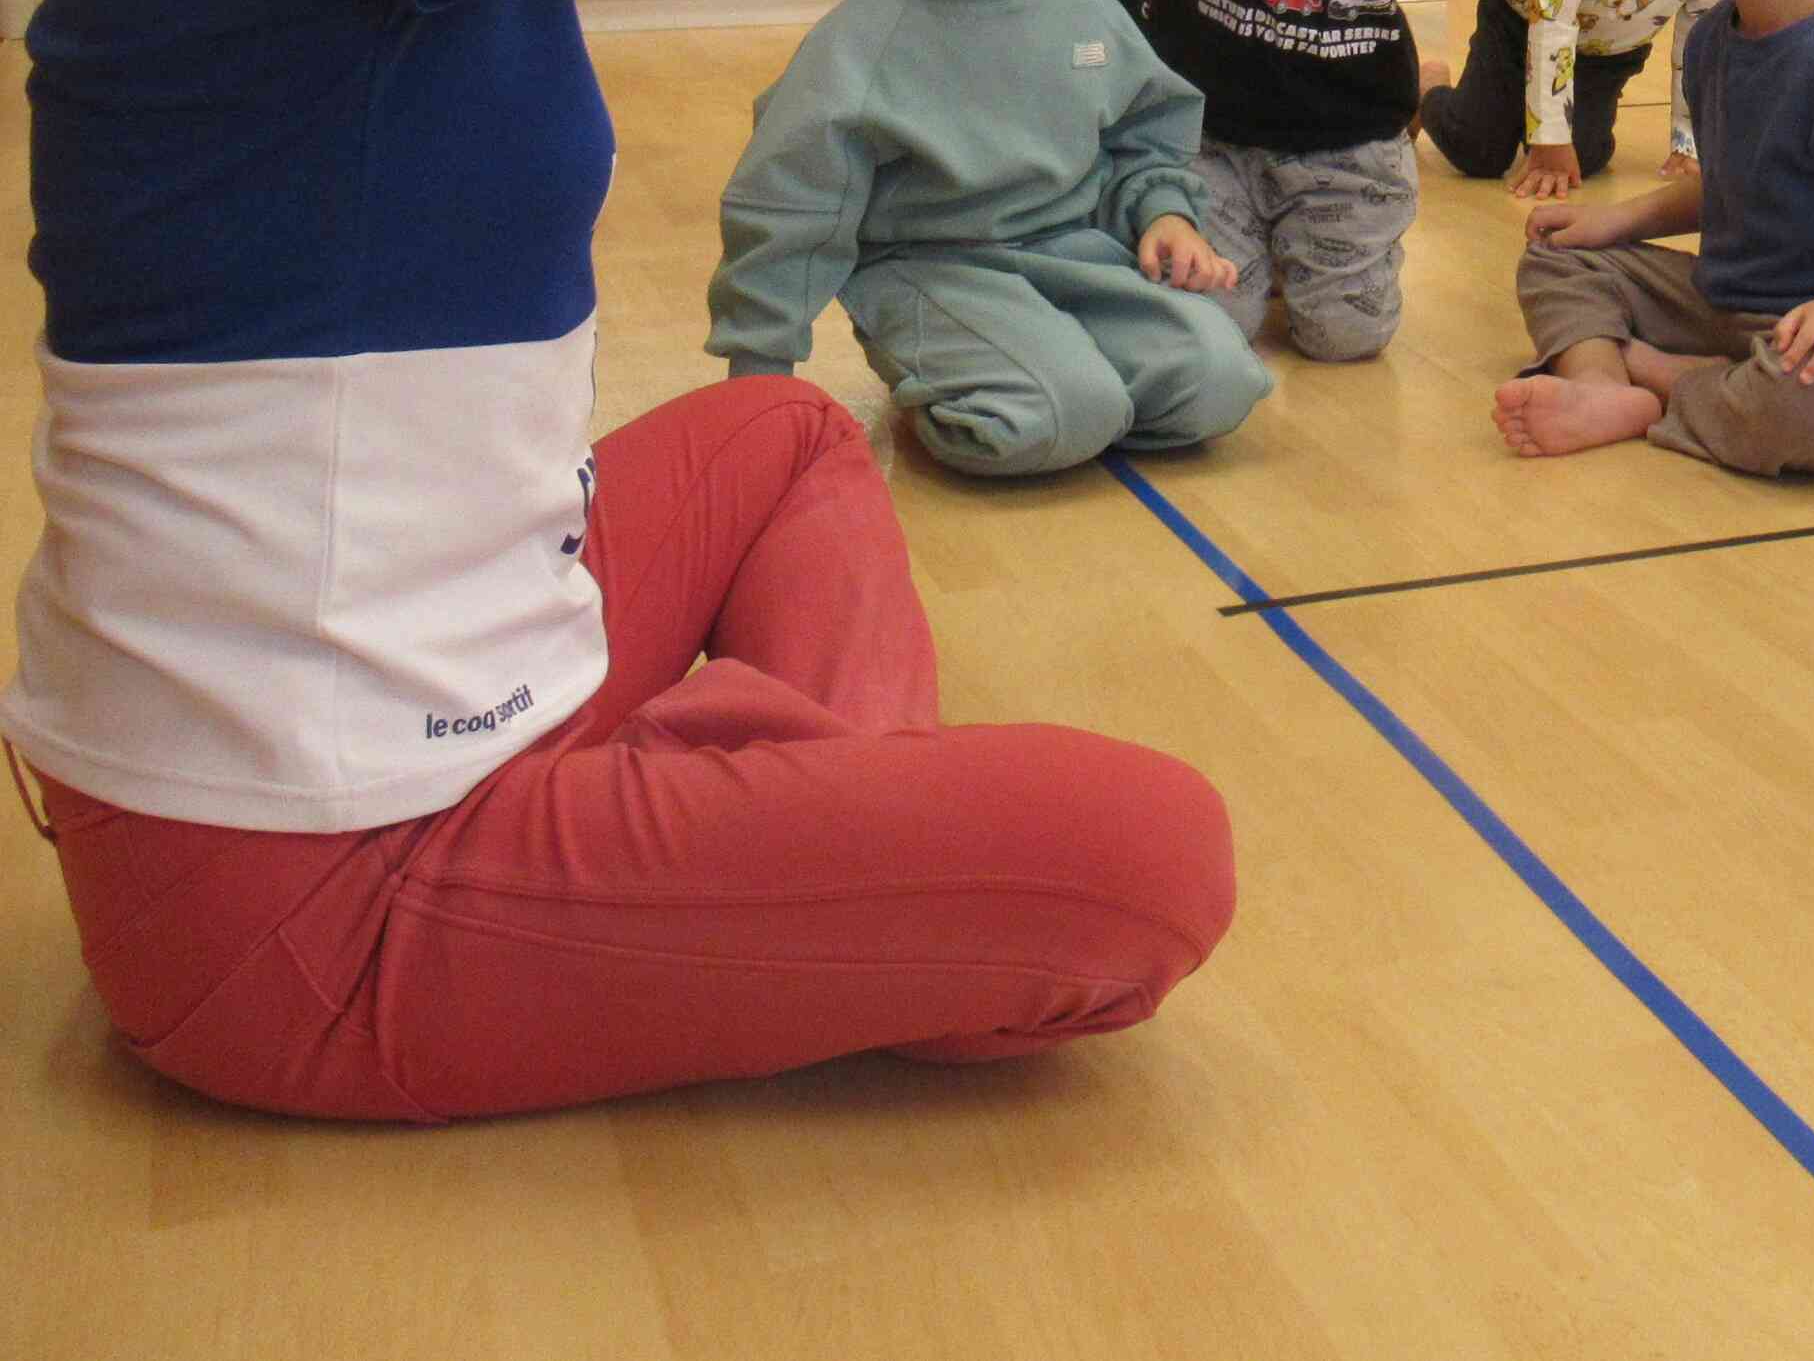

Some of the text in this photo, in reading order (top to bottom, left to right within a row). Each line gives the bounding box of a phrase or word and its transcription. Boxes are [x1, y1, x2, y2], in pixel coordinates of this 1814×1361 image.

[1238, 23, 1253, 37] IS
[1344, 27, 1400, 42] SERIES
[425, 713, 449, 739] le
[452, 709, 497, 735] coq
